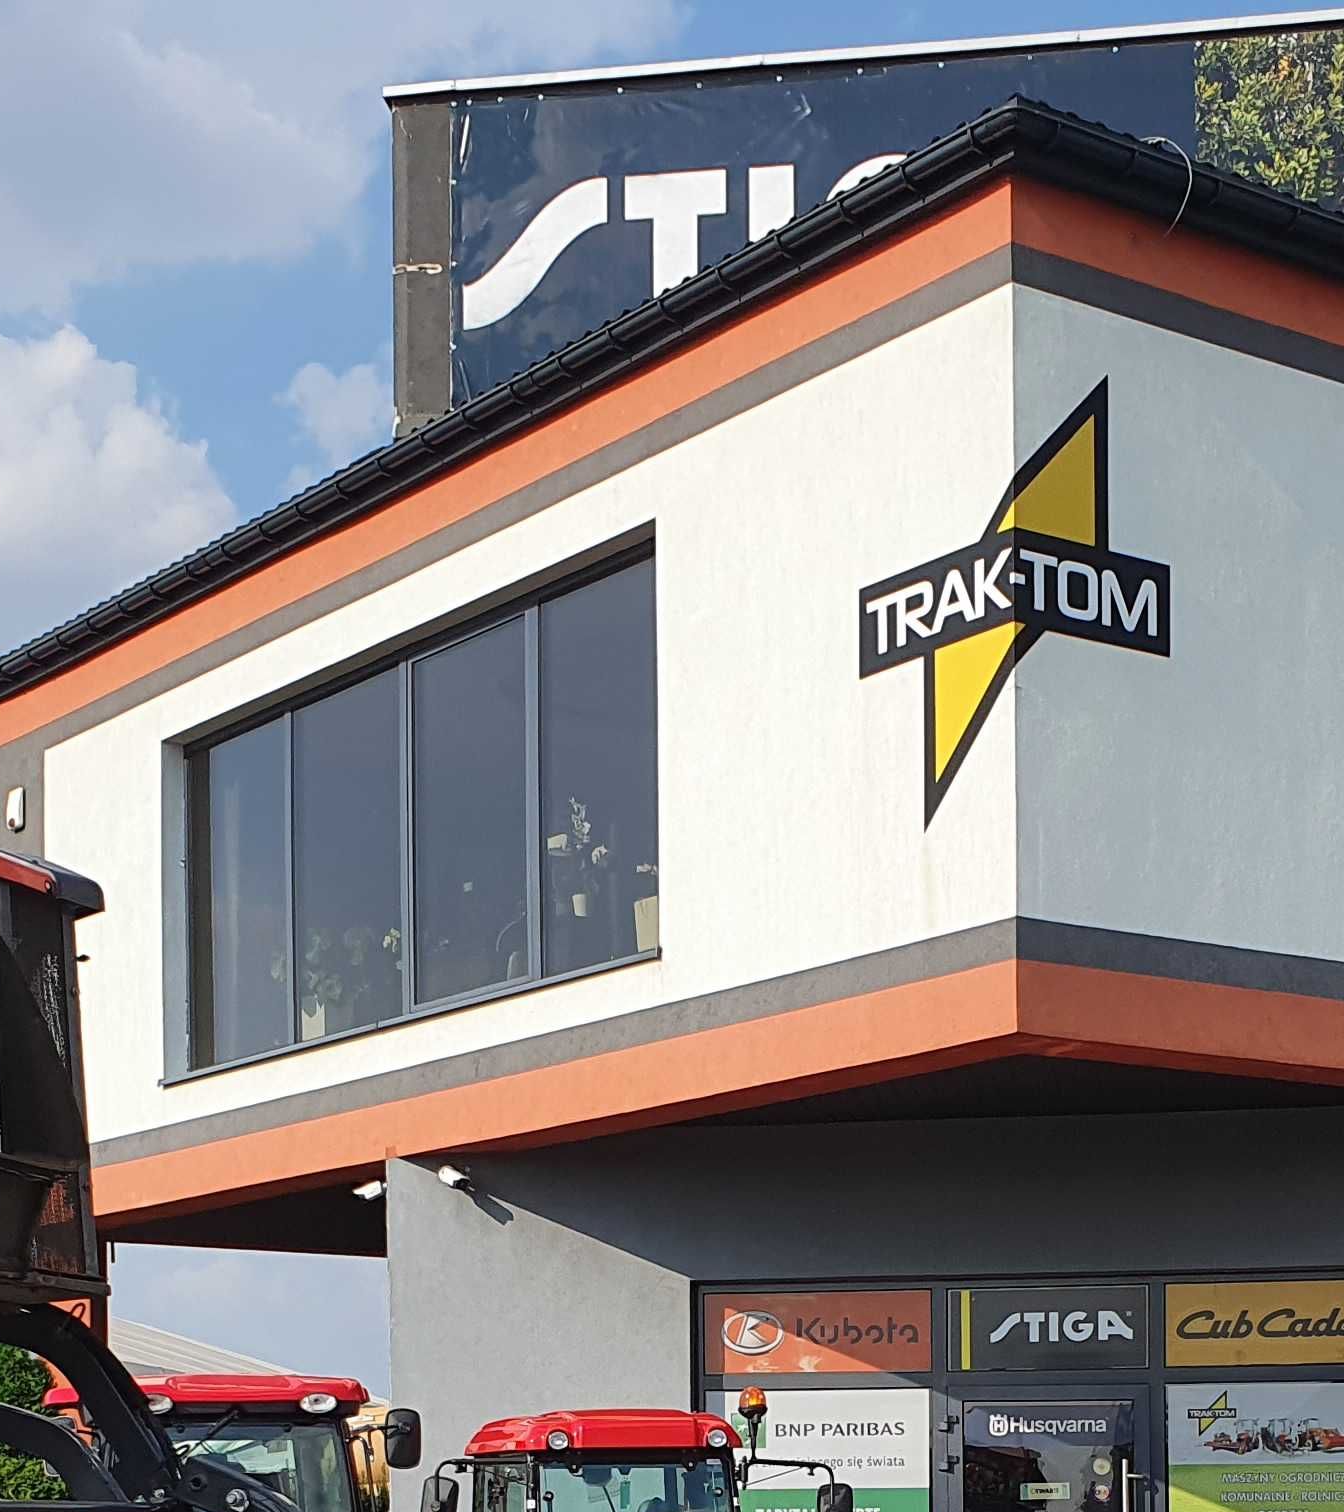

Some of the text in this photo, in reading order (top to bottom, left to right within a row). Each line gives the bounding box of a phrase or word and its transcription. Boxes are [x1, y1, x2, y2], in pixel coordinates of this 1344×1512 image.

[866, 546, 1158, 656] TRAK-TOM
[796, 1316, 920, 1345] Kubota
[989, 1310, 1134, 1344] STIGA
[1176, 1309, 1254, 1340] Cub
[1189, 1409, 1236, 1418] TRAK-TOM
[775, 1422, 905, 1438] BNP PARIBAS
[1010, 1416, 1107, 1435] Husqvarna
[847, 1456, 864, 1469] się
[867, 1455, 905, 1467] świata
[1222, 1472, 1275, 1483] MASZYNY
[1220, 1490, 1290, 1502] KOMUNALNE
